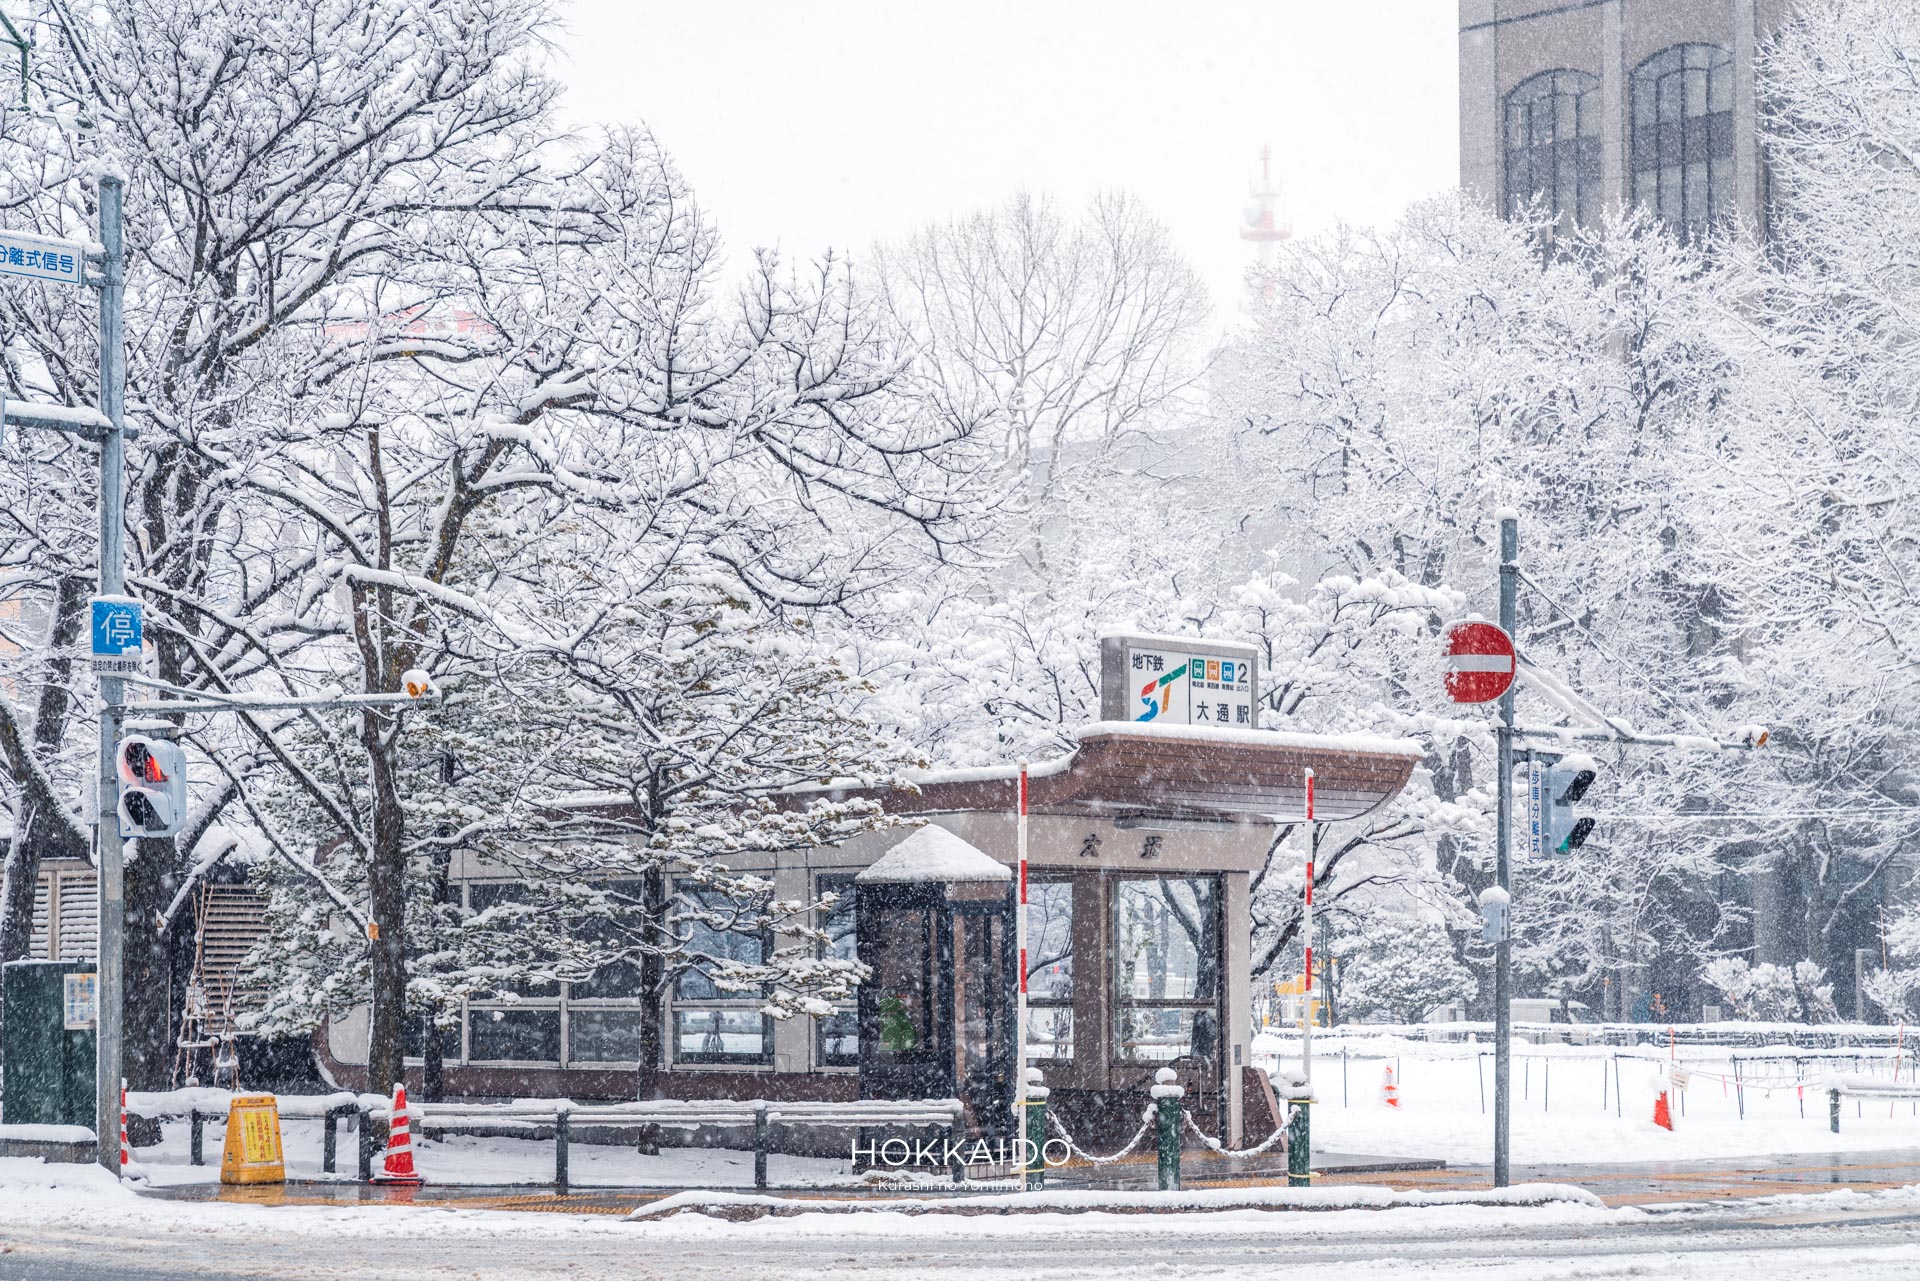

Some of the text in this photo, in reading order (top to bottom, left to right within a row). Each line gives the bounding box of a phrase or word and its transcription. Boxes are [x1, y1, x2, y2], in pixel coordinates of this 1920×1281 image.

[100, 610, 135, 646] 停
[1132, 652, 1164, 671] 地下鉄
[1238, 663, 1248, 684] 2
[1196, 700, 1250, 724] 大通駅
